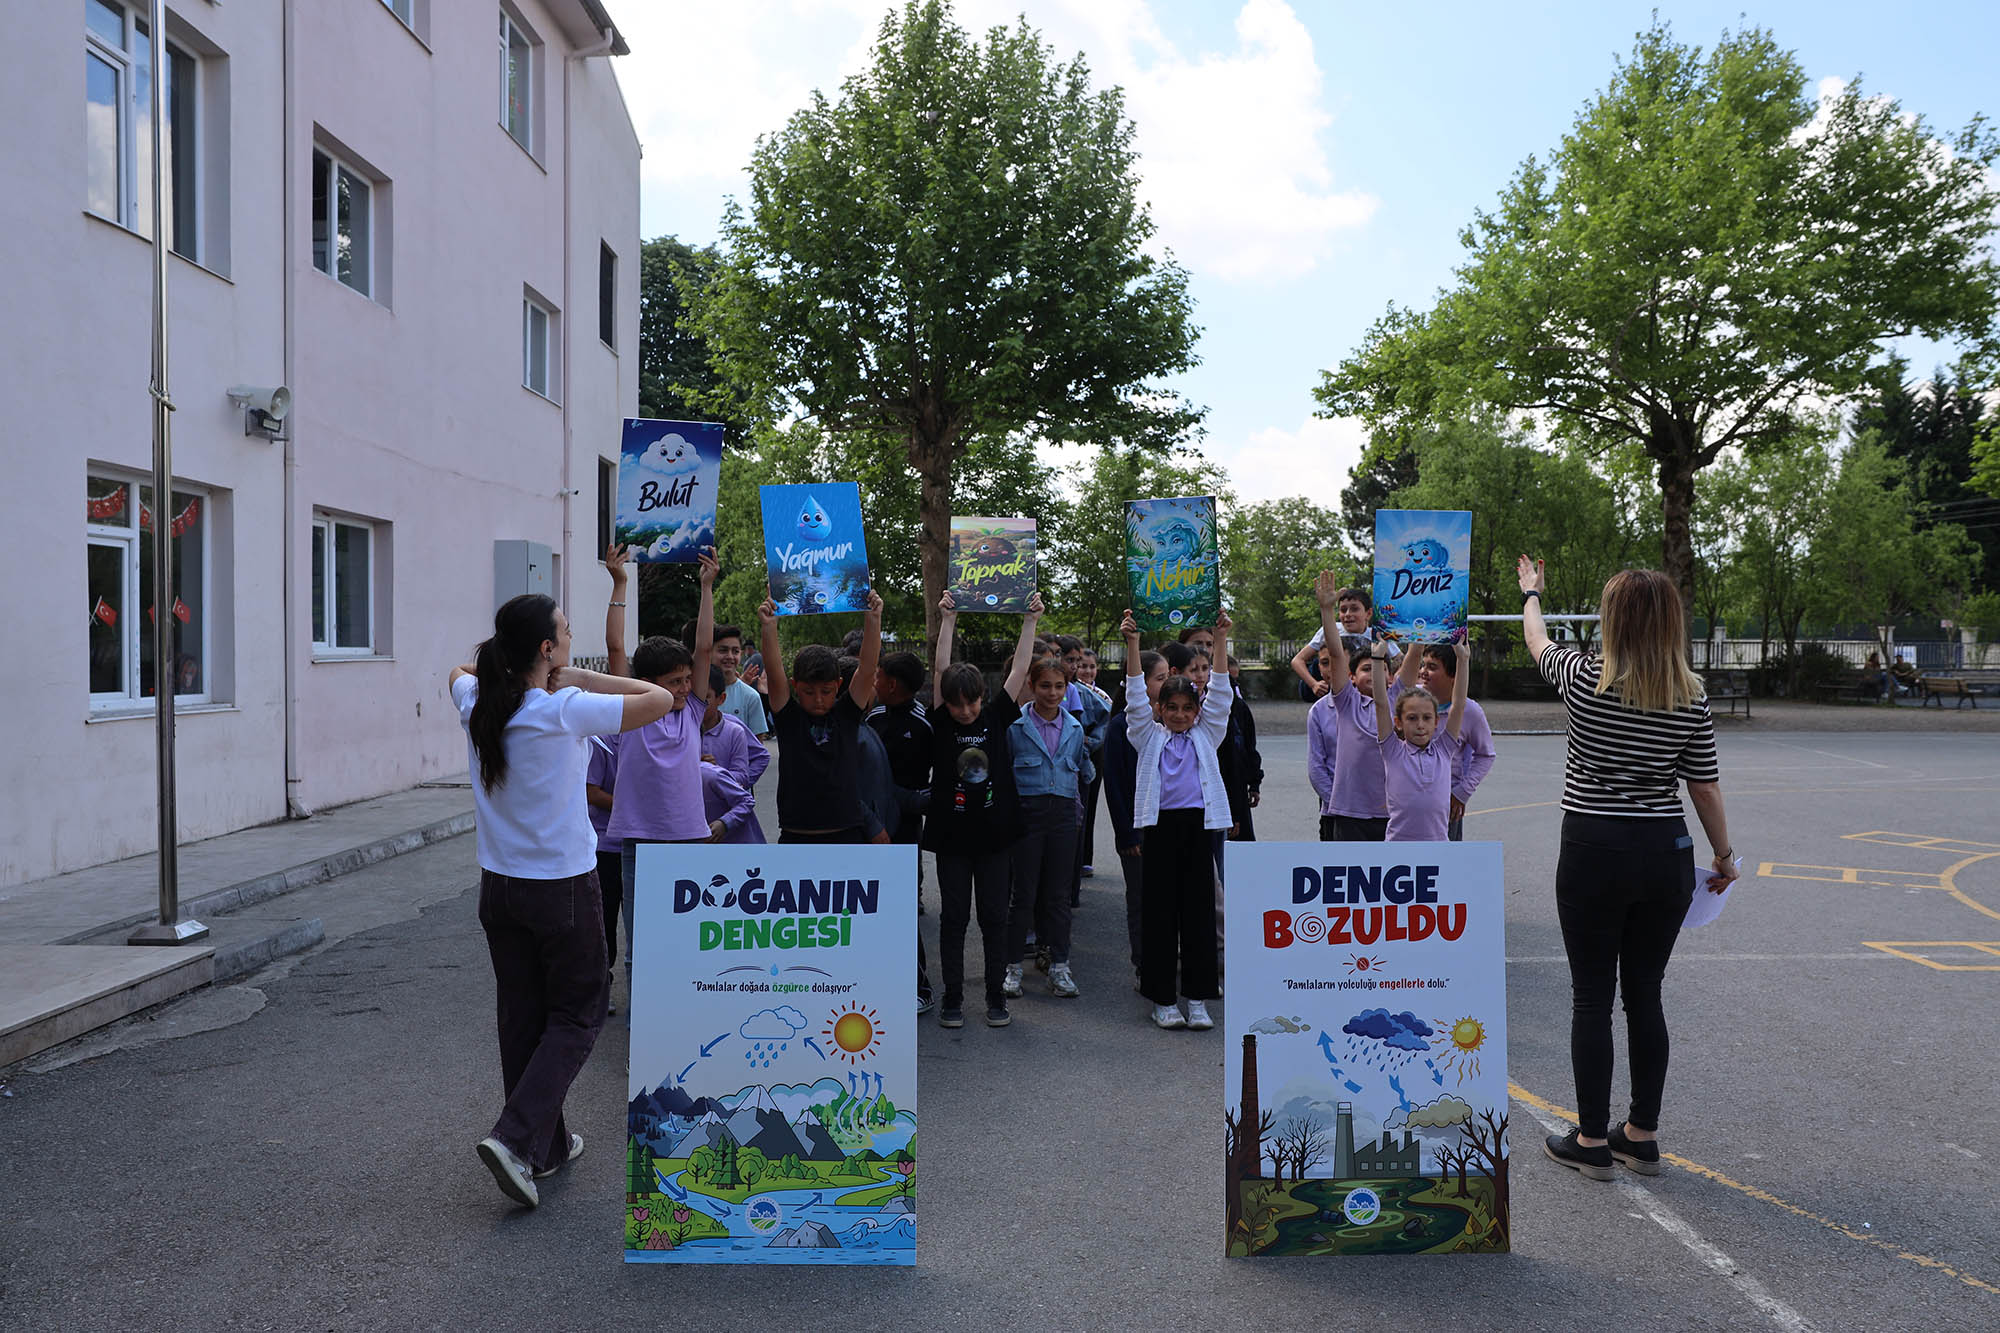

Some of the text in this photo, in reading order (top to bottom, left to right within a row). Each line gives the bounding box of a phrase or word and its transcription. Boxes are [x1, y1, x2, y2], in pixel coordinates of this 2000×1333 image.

[637, 475, 699, 512] Bulut
[775, 542, 853, 576] Yağmur
[955, 553, 1026, 585] Toprak
[1146, 559, 1205, 597] Nehir
[1391, 567, 1454, 600] Deniz
[673, 867, 880, 915] DOĞANIN
[1292, 865, 1440, 904] DENGE
[700, 908, 852, 951] DENGESİ
[1263, 903, 1467, 949] BOZULDU
[739, 981, 770, 994] doğada
[772, 982, 810, 994] özgürce
[1337, 979, 1377, 992] yolculuğu
[1379, 978, 1425, 990] engellerle
